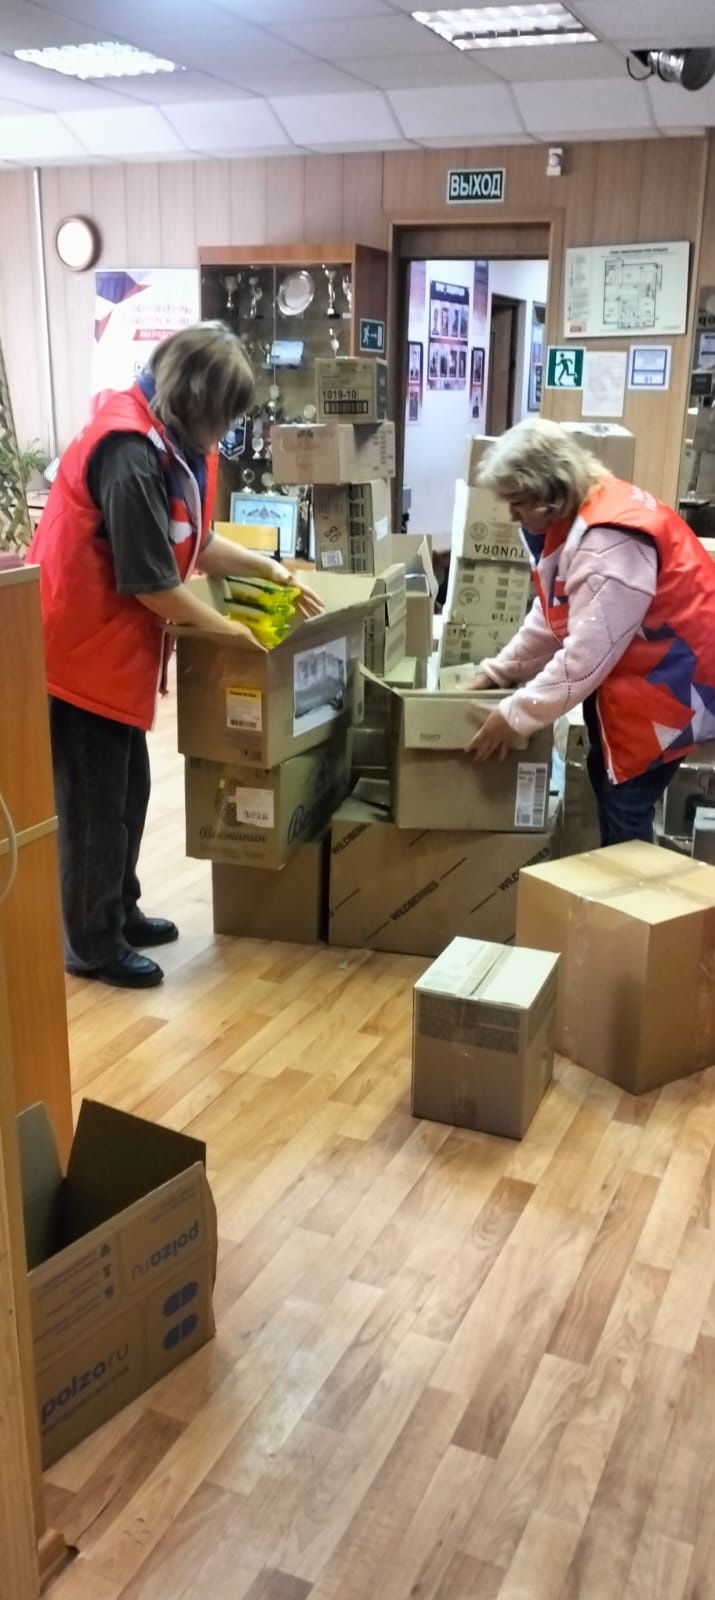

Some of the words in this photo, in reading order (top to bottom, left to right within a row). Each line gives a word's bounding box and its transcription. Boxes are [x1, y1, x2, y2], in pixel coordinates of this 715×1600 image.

[450, 173, 502, 198] ВЫХОД
[322, 389, 357, 400] 1019-10
[473, 542, 526, 559] TUNDRA
[389, 879, 440, 921] WILDBERRIES
